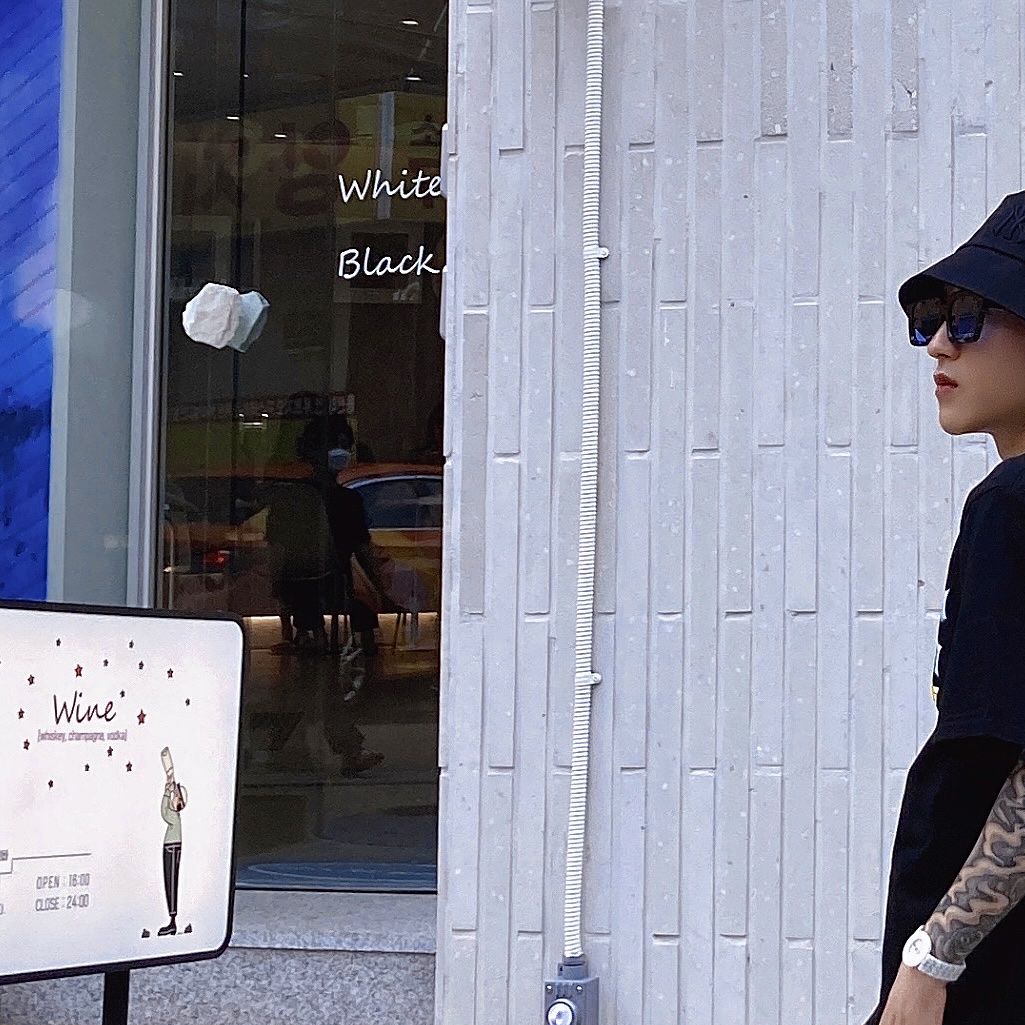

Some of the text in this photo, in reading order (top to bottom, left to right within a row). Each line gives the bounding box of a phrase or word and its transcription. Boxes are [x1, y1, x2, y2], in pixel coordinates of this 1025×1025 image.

[338, 169, 441, 203] White
[53, 690, 117, 725] Wine
[36, 875, 60, 890] OPEN
[35, 896, 60, 912] CLOSE
